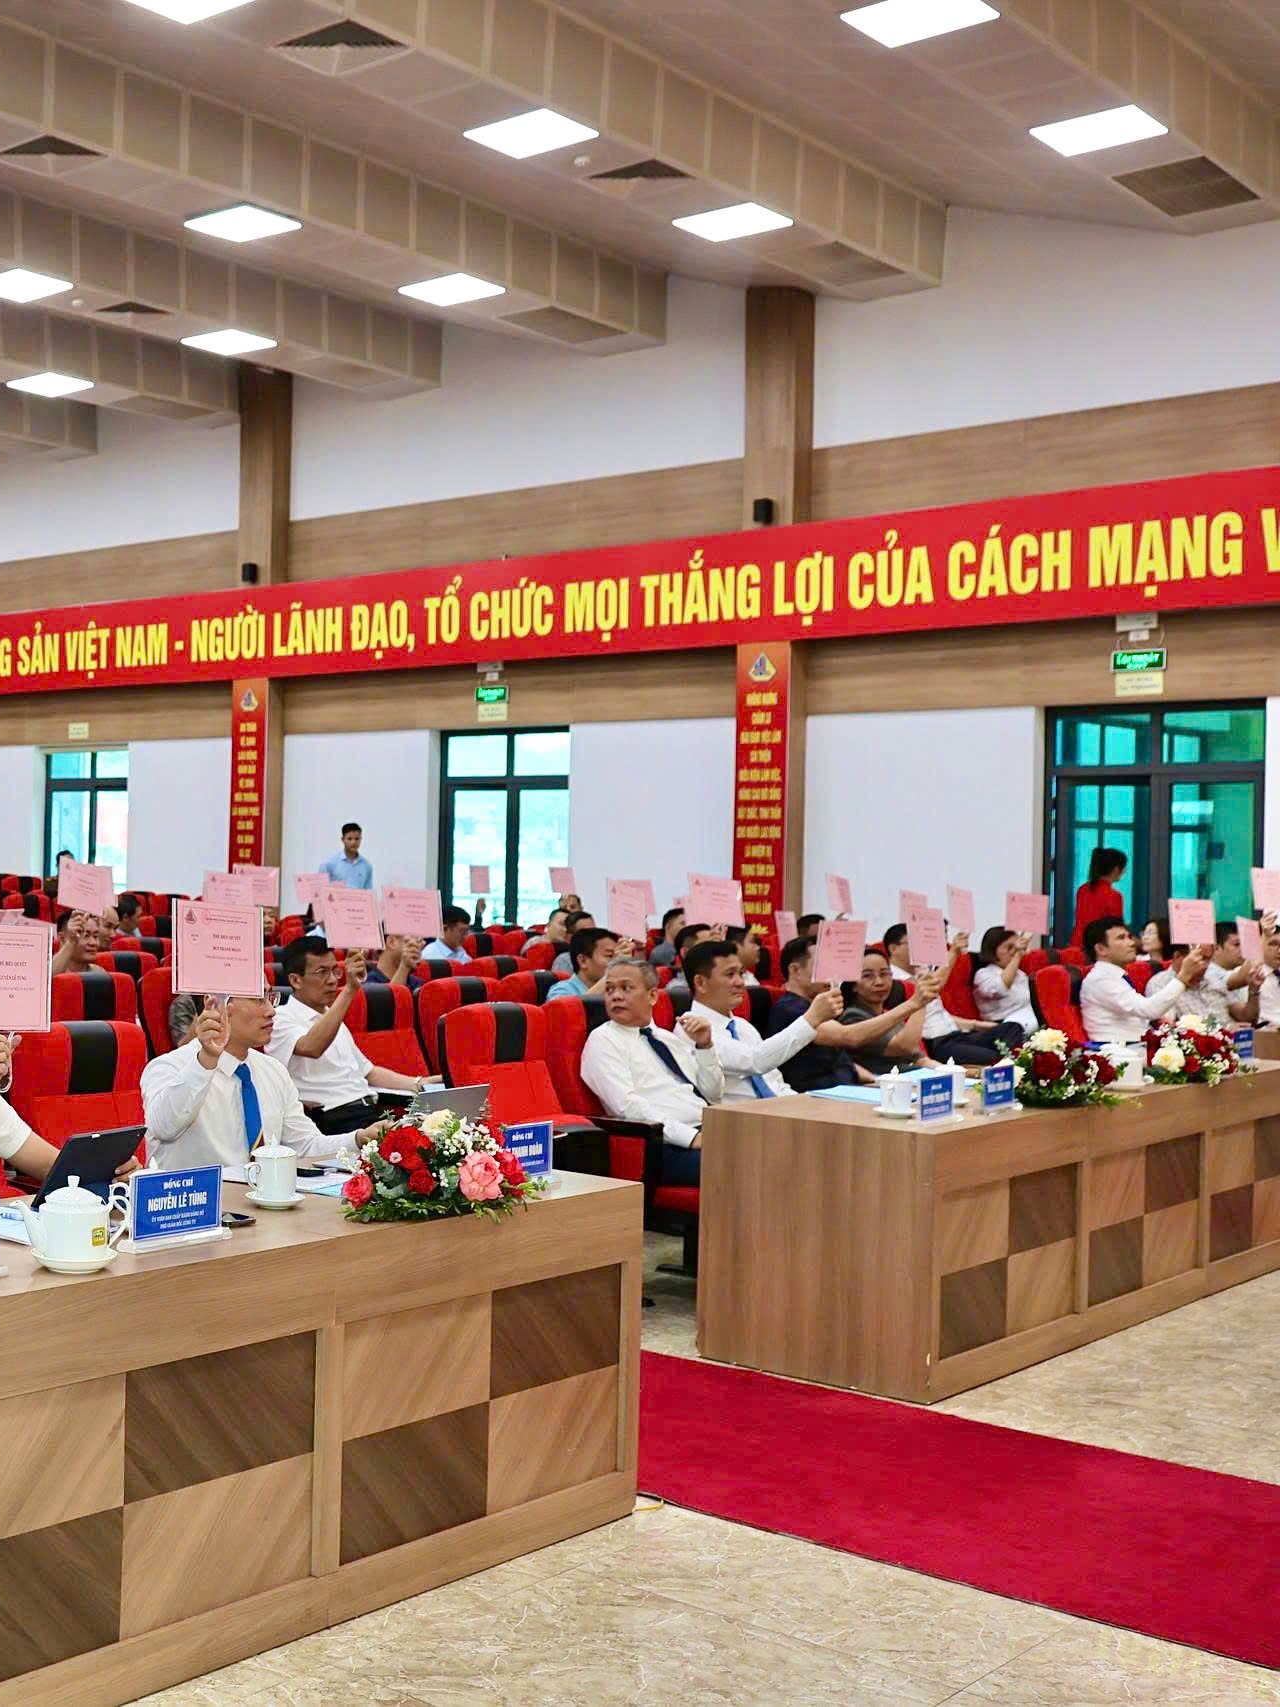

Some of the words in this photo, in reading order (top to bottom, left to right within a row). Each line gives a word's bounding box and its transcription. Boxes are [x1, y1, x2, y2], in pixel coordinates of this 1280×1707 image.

[16, 621, 60, 676] SẢN
[64, 620, 111, 679] VIỆT
[115, 622, 169, 668] NAM
[190, 604, 266, 663] NGƯỜI
[272, 601, 344, 657] LÃNH
[349, 599, 416, 660] ĐẠO,
[423, 575, 463, 645] TỔ
[469, 576, 554, 641] CHỨC
[564, 577, 630, 643] MỌI
[639, 549, 761, 628] THẮNG
[773, 551, 835, 627] LỢI
[847, 529, 935, 610] CỦA
[947, 524, 1072, 601] CÁCH
[1088, 511, 1244, 598] MẠNG
[163, 1178, 181, 1190] ĐỒNG
[182, 1175, 194, 1187] CHÍ
[147, 1191, 177, 1212] NGUYỄN
[178, 1192, 187, 1208] LÊ
[188, 1190, 208, 1206] TÙNG
